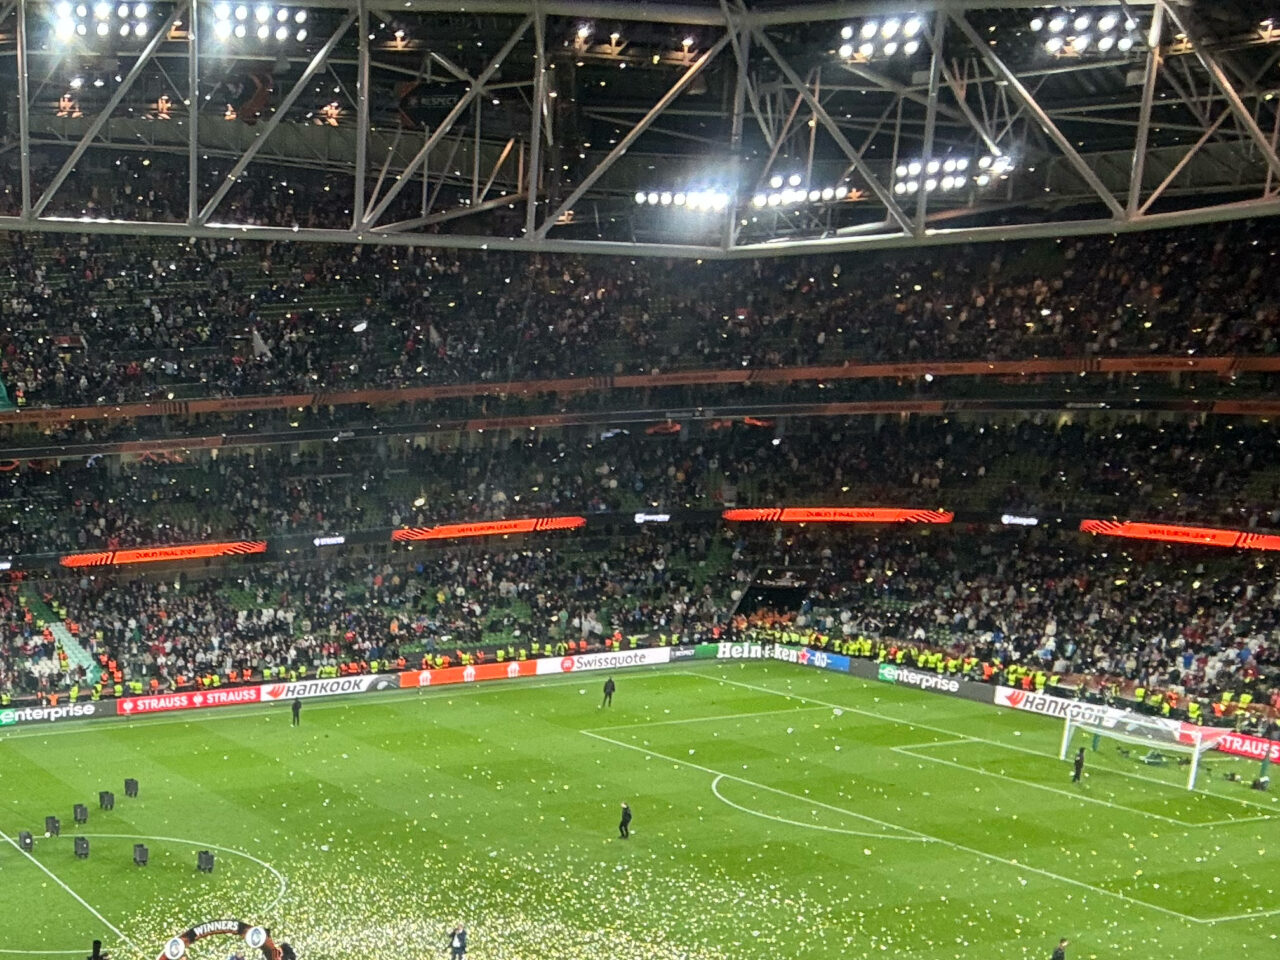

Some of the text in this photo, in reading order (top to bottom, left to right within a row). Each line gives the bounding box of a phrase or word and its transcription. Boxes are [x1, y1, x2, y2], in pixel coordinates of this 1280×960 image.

[576, 652, 646, 669] Swissquote
[879, 665, 960, 693] enterprise
[136, 695, 189, 711] STRAUSS
[206, 689, 257, 705] STRAUSS
[193, 920, 239, 936] WINNERS
